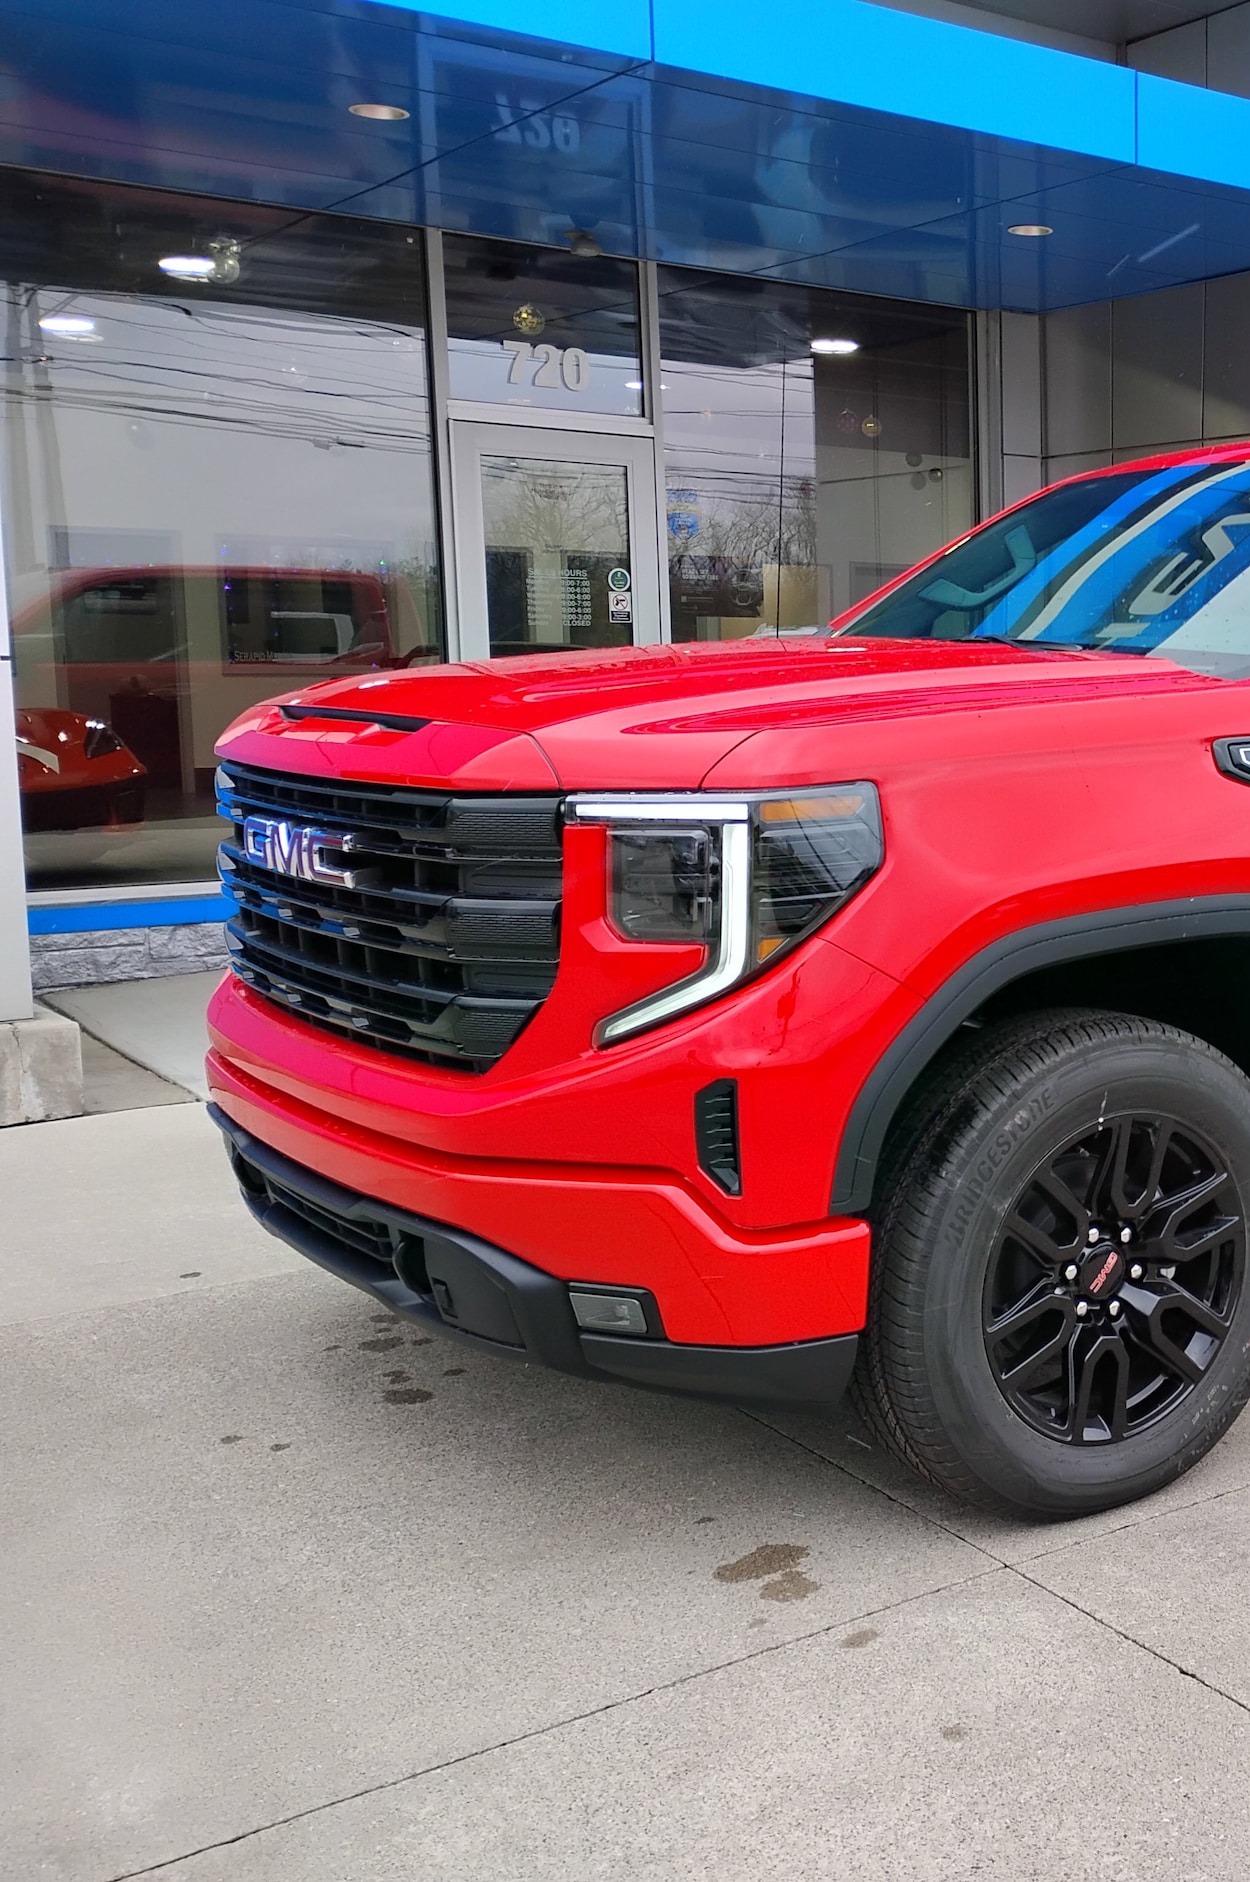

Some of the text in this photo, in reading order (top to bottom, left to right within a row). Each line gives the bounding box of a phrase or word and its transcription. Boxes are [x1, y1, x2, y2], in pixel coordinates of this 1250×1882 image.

[502, 339, 590, 392] 720
[559, 568, 588, 578] HOURS
[244, 815, 356, 889] GMC
[1090, 1251, 1118, 1293] GMC
